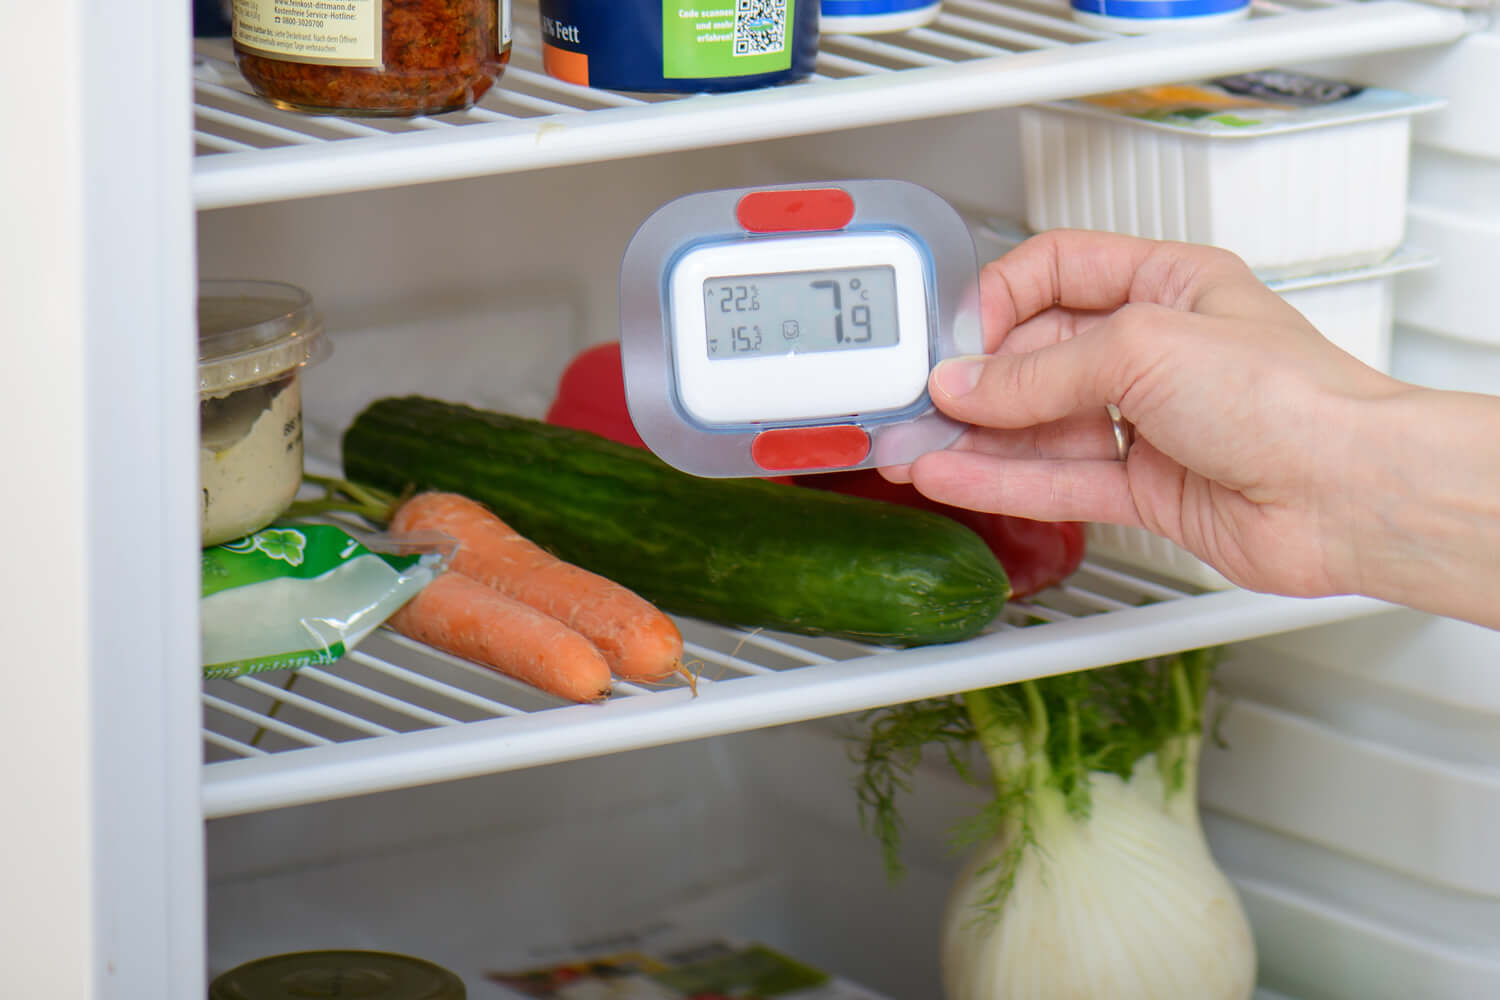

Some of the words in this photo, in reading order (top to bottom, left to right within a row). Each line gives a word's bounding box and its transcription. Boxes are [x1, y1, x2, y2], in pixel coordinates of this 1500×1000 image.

[274, 0, 356, 11] www.feinkost-dittmann.de
[274, 7, 305, 19] Kostenfreie
[306, 9, 356, 21] Service-Hotline:
[678, 9, 699, 18] Code
[701, 8, 734, 18] scannen
[695, 21, 711, 30] und
[713, 20, 734, 30] mehr
[555, 20, 580, 44] Fett
[696, 32, 733, 43] erfahren!
